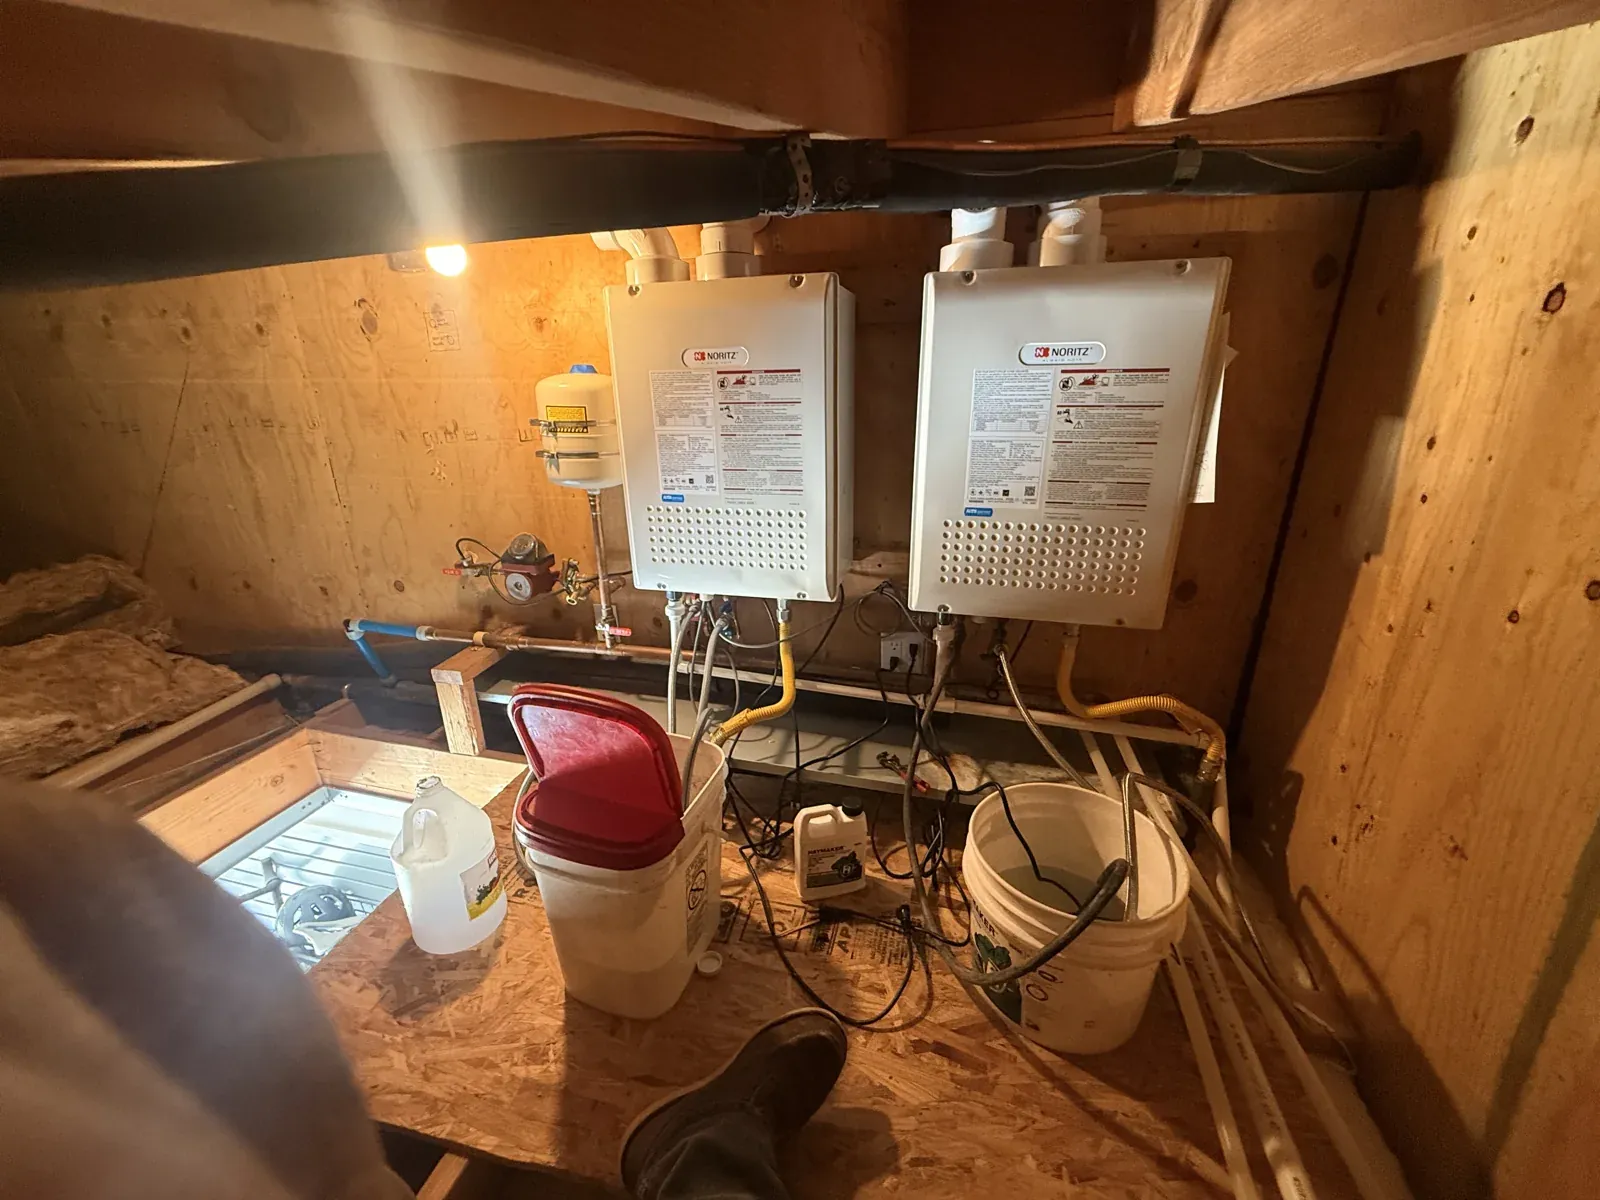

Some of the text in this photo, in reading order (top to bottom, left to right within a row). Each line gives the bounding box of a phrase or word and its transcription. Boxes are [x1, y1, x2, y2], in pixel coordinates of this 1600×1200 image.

[707, 351, 736, 360] NORITZ
[1051, 347, 1089, 357] NORITZ
[807, 846, 844, 855] HAYMAKER
